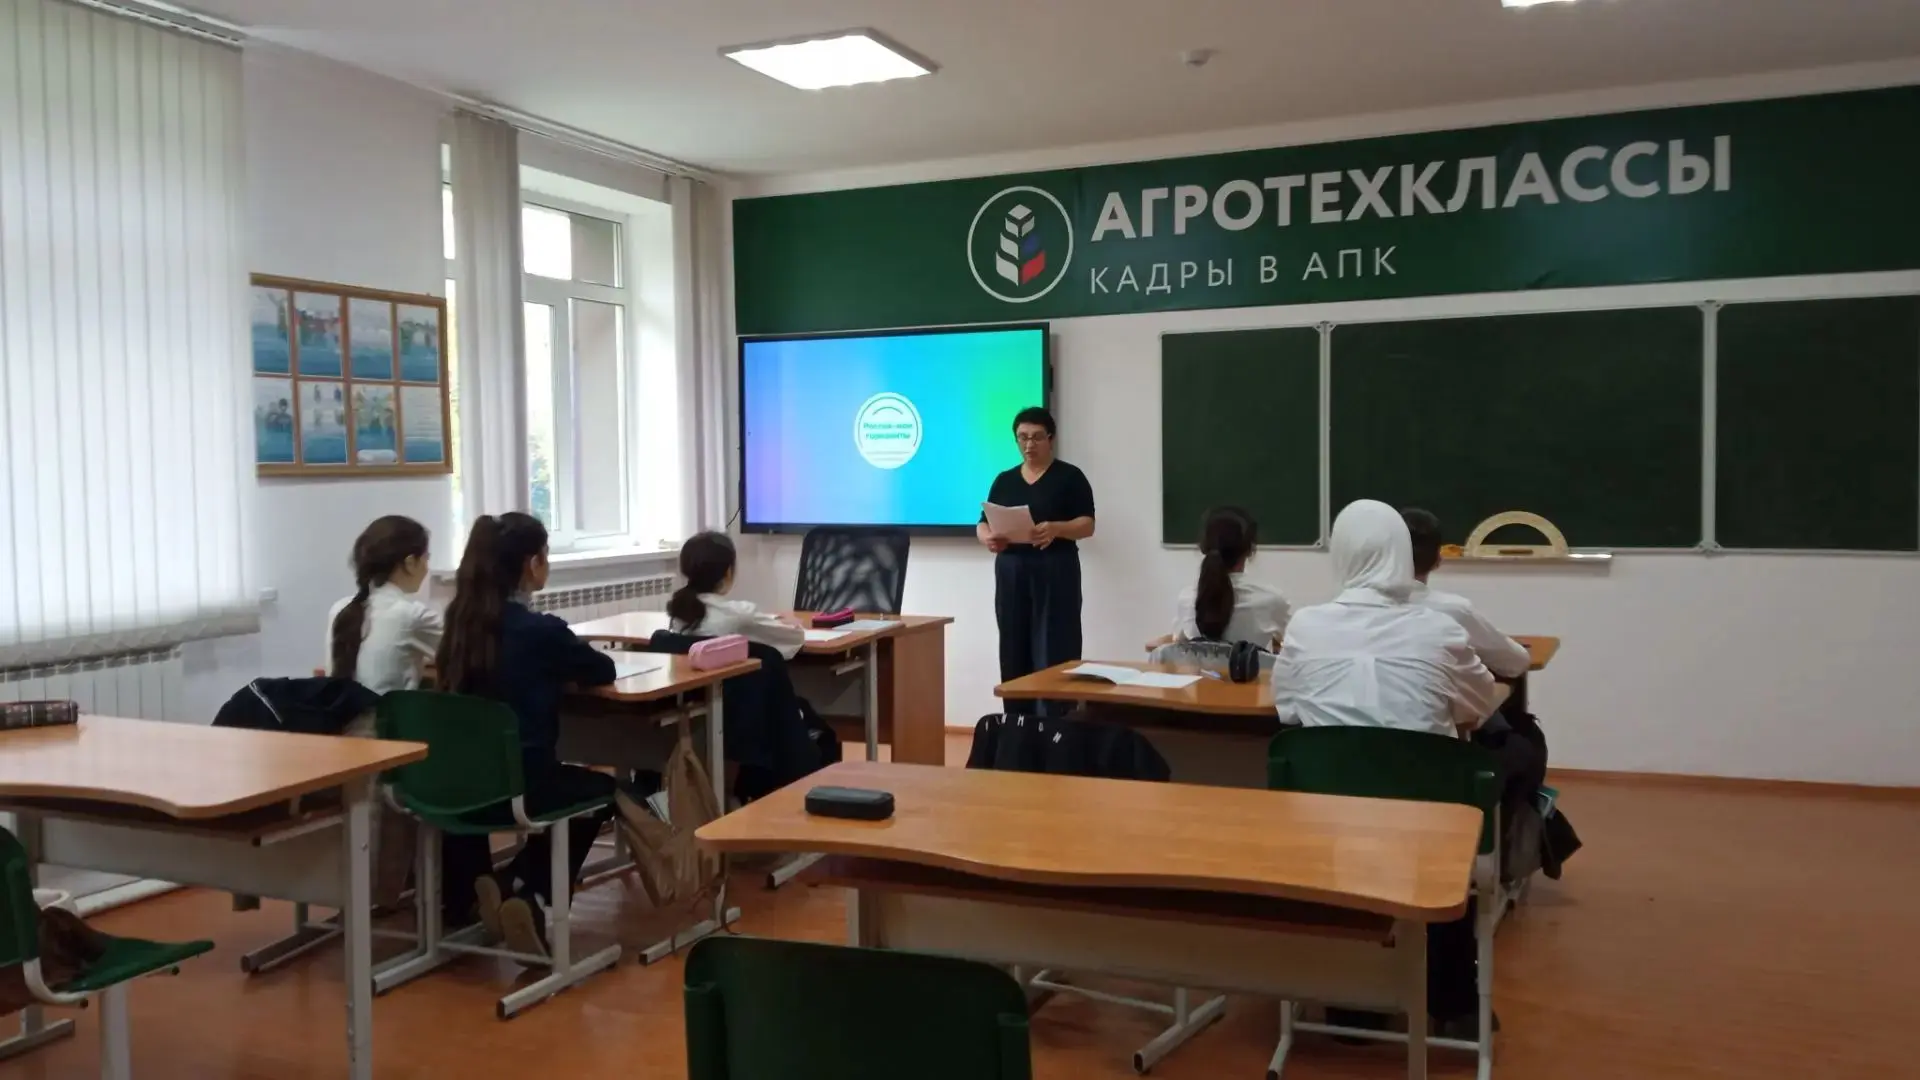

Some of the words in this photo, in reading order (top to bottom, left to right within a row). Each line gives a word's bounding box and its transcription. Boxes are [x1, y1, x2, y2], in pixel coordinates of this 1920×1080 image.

[1090, 135, 1731, 242] АГРОТЕХКЛАССЫ
[1089, 257, 1234, 297] КАДРЫ
[1259, 255, 1278, 284] В
[1302, 245, 1398, 281] АПК
